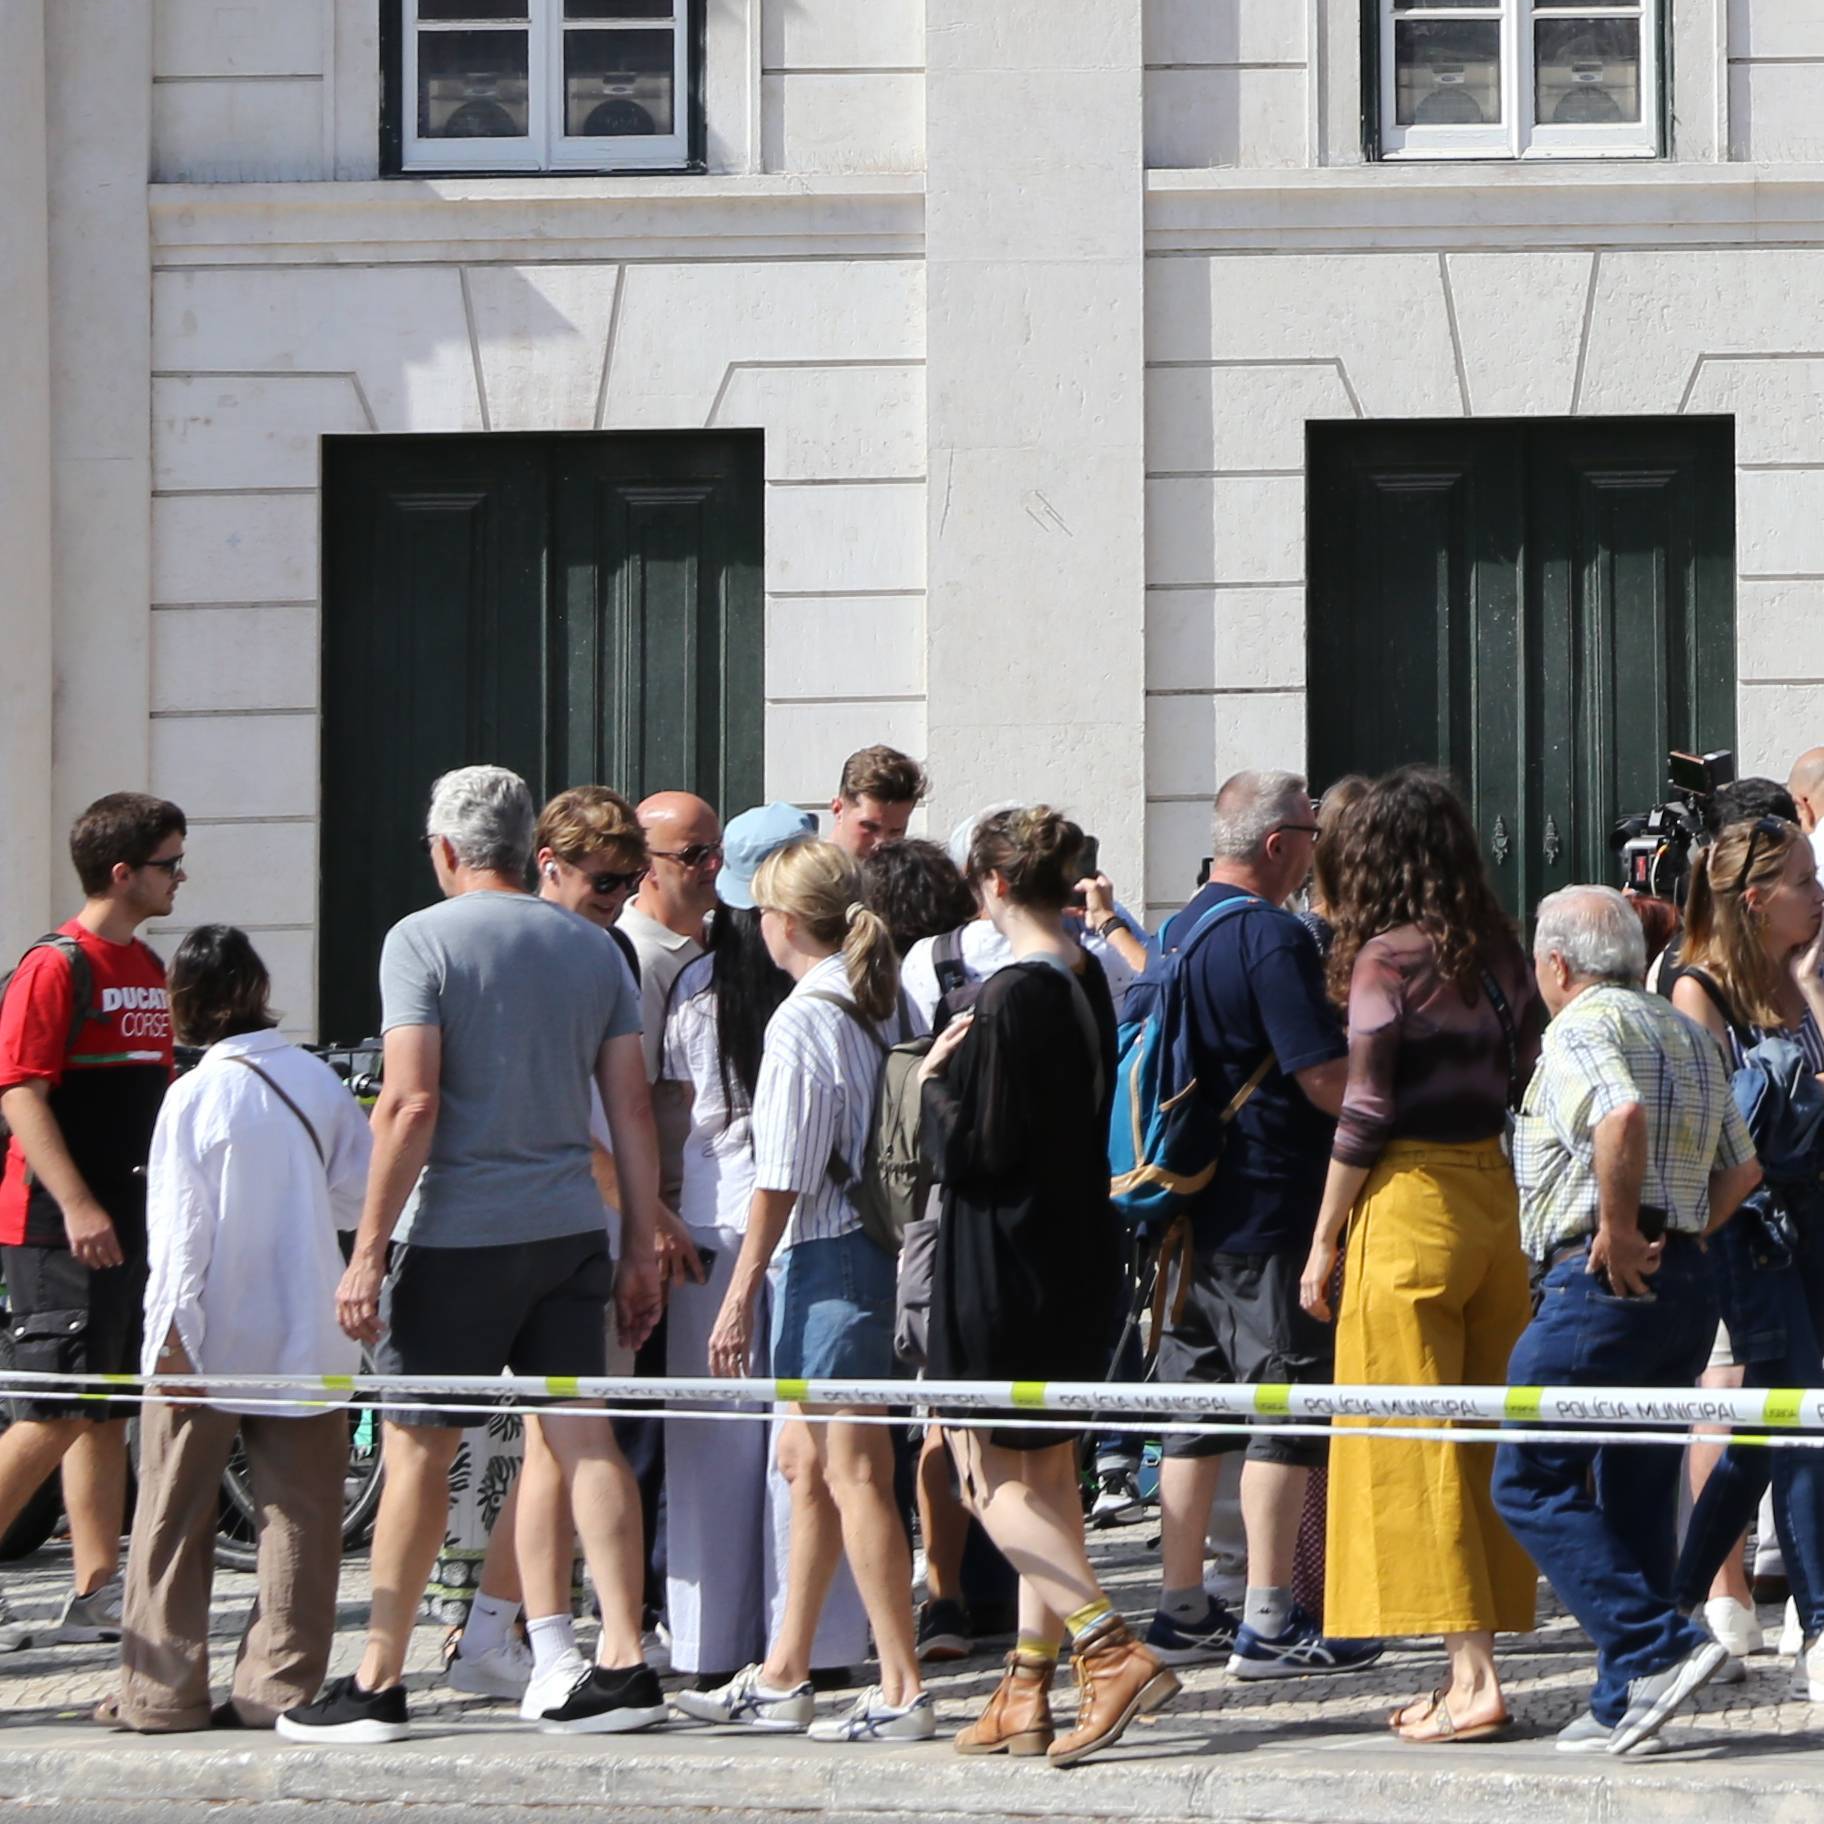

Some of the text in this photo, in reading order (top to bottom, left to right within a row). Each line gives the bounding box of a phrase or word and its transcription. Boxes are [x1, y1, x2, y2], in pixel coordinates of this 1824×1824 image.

[102, 987, 168, 1012] DUCAT
[121, 1012, 168, 1037] CORSE
[1556, 1396, 1748, 1421] POLÍCIA MUNICIPAL
